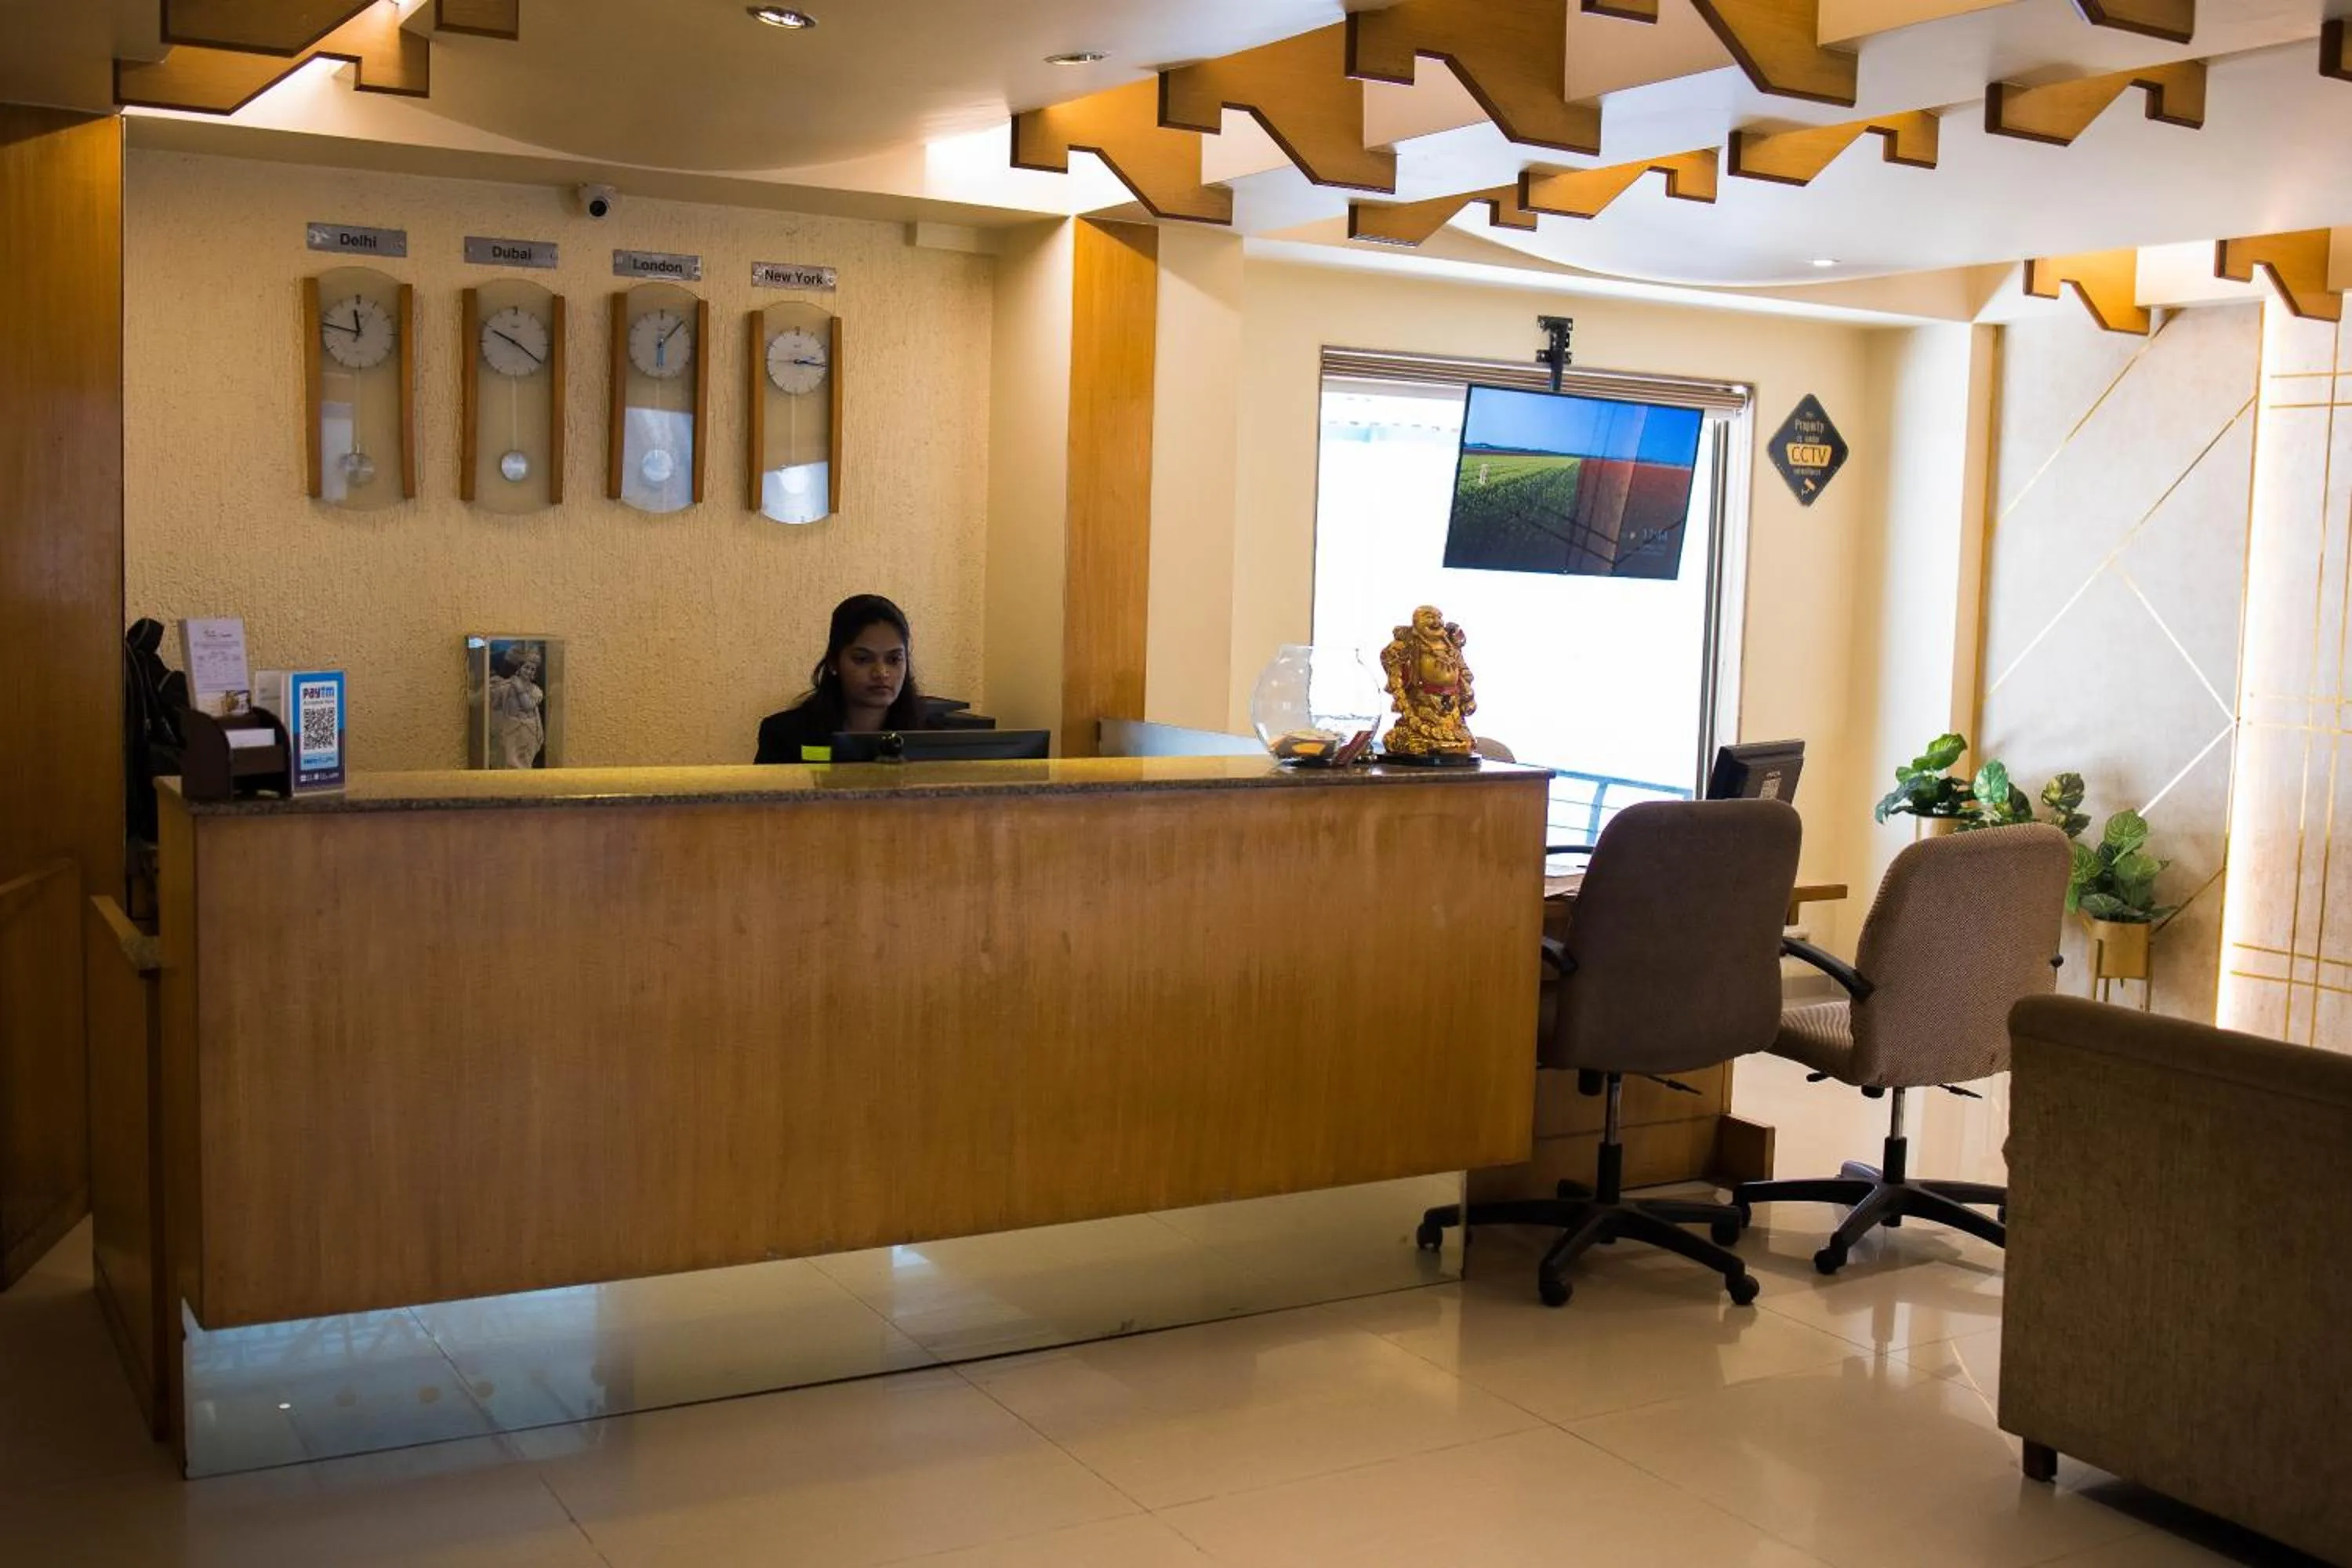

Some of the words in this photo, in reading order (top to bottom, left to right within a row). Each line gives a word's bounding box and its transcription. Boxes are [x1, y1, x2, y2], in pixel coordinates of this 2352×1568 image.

[339, 233, 377, 249] Delhi
[492, 245, 532, 260] Dubai
[633, 258, 683, 273] London
[764, 269, 792, 282] New
[795, 270, 823, 285] York
[1791, 446, 1828, 465] CCTV
